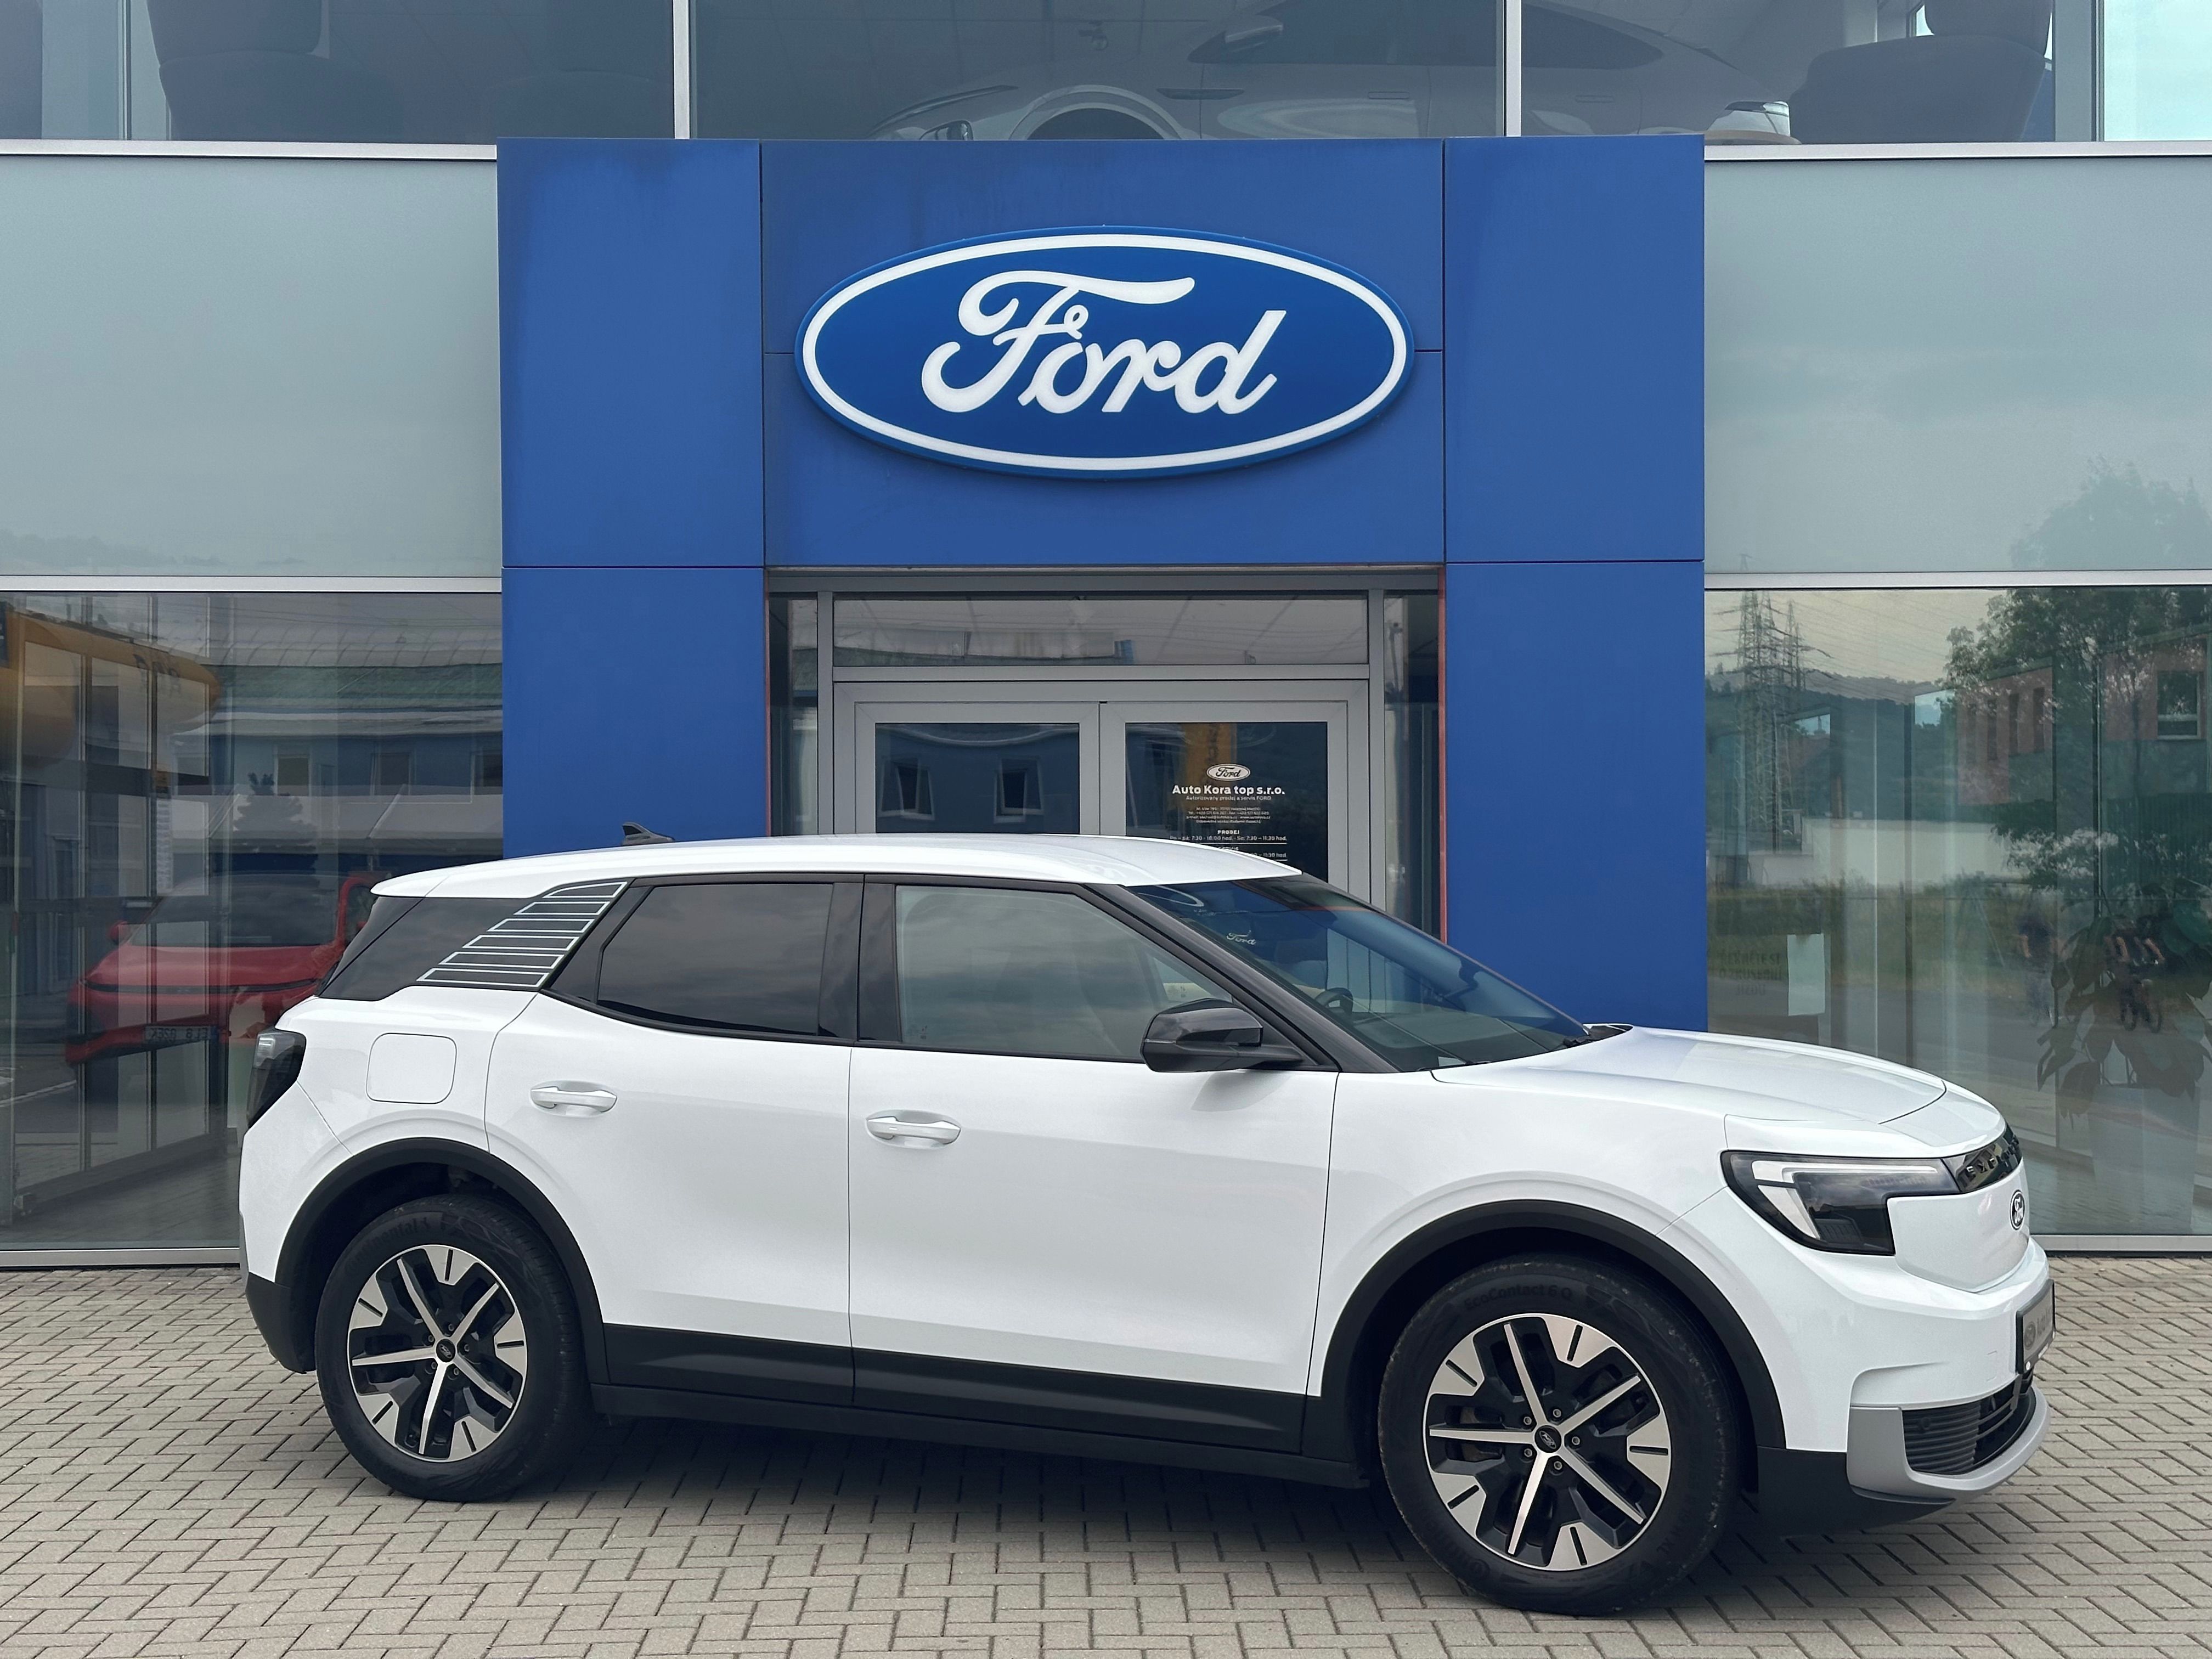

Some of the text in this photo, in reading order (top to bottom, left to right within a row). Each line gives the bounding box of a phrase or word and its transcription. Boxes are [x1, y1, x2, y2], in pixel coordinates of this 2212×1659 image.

[921, 269, 1286, 414] Ford
[1215, 766, 1242, 777] Ford
[1172, 785, 1201, 794] Auto
[1204, 785, 1232, 794] Kora
[1233, 786, 1254, 795] top
[1464, 1283, 1573, 1310] EcoContact 6 Q
